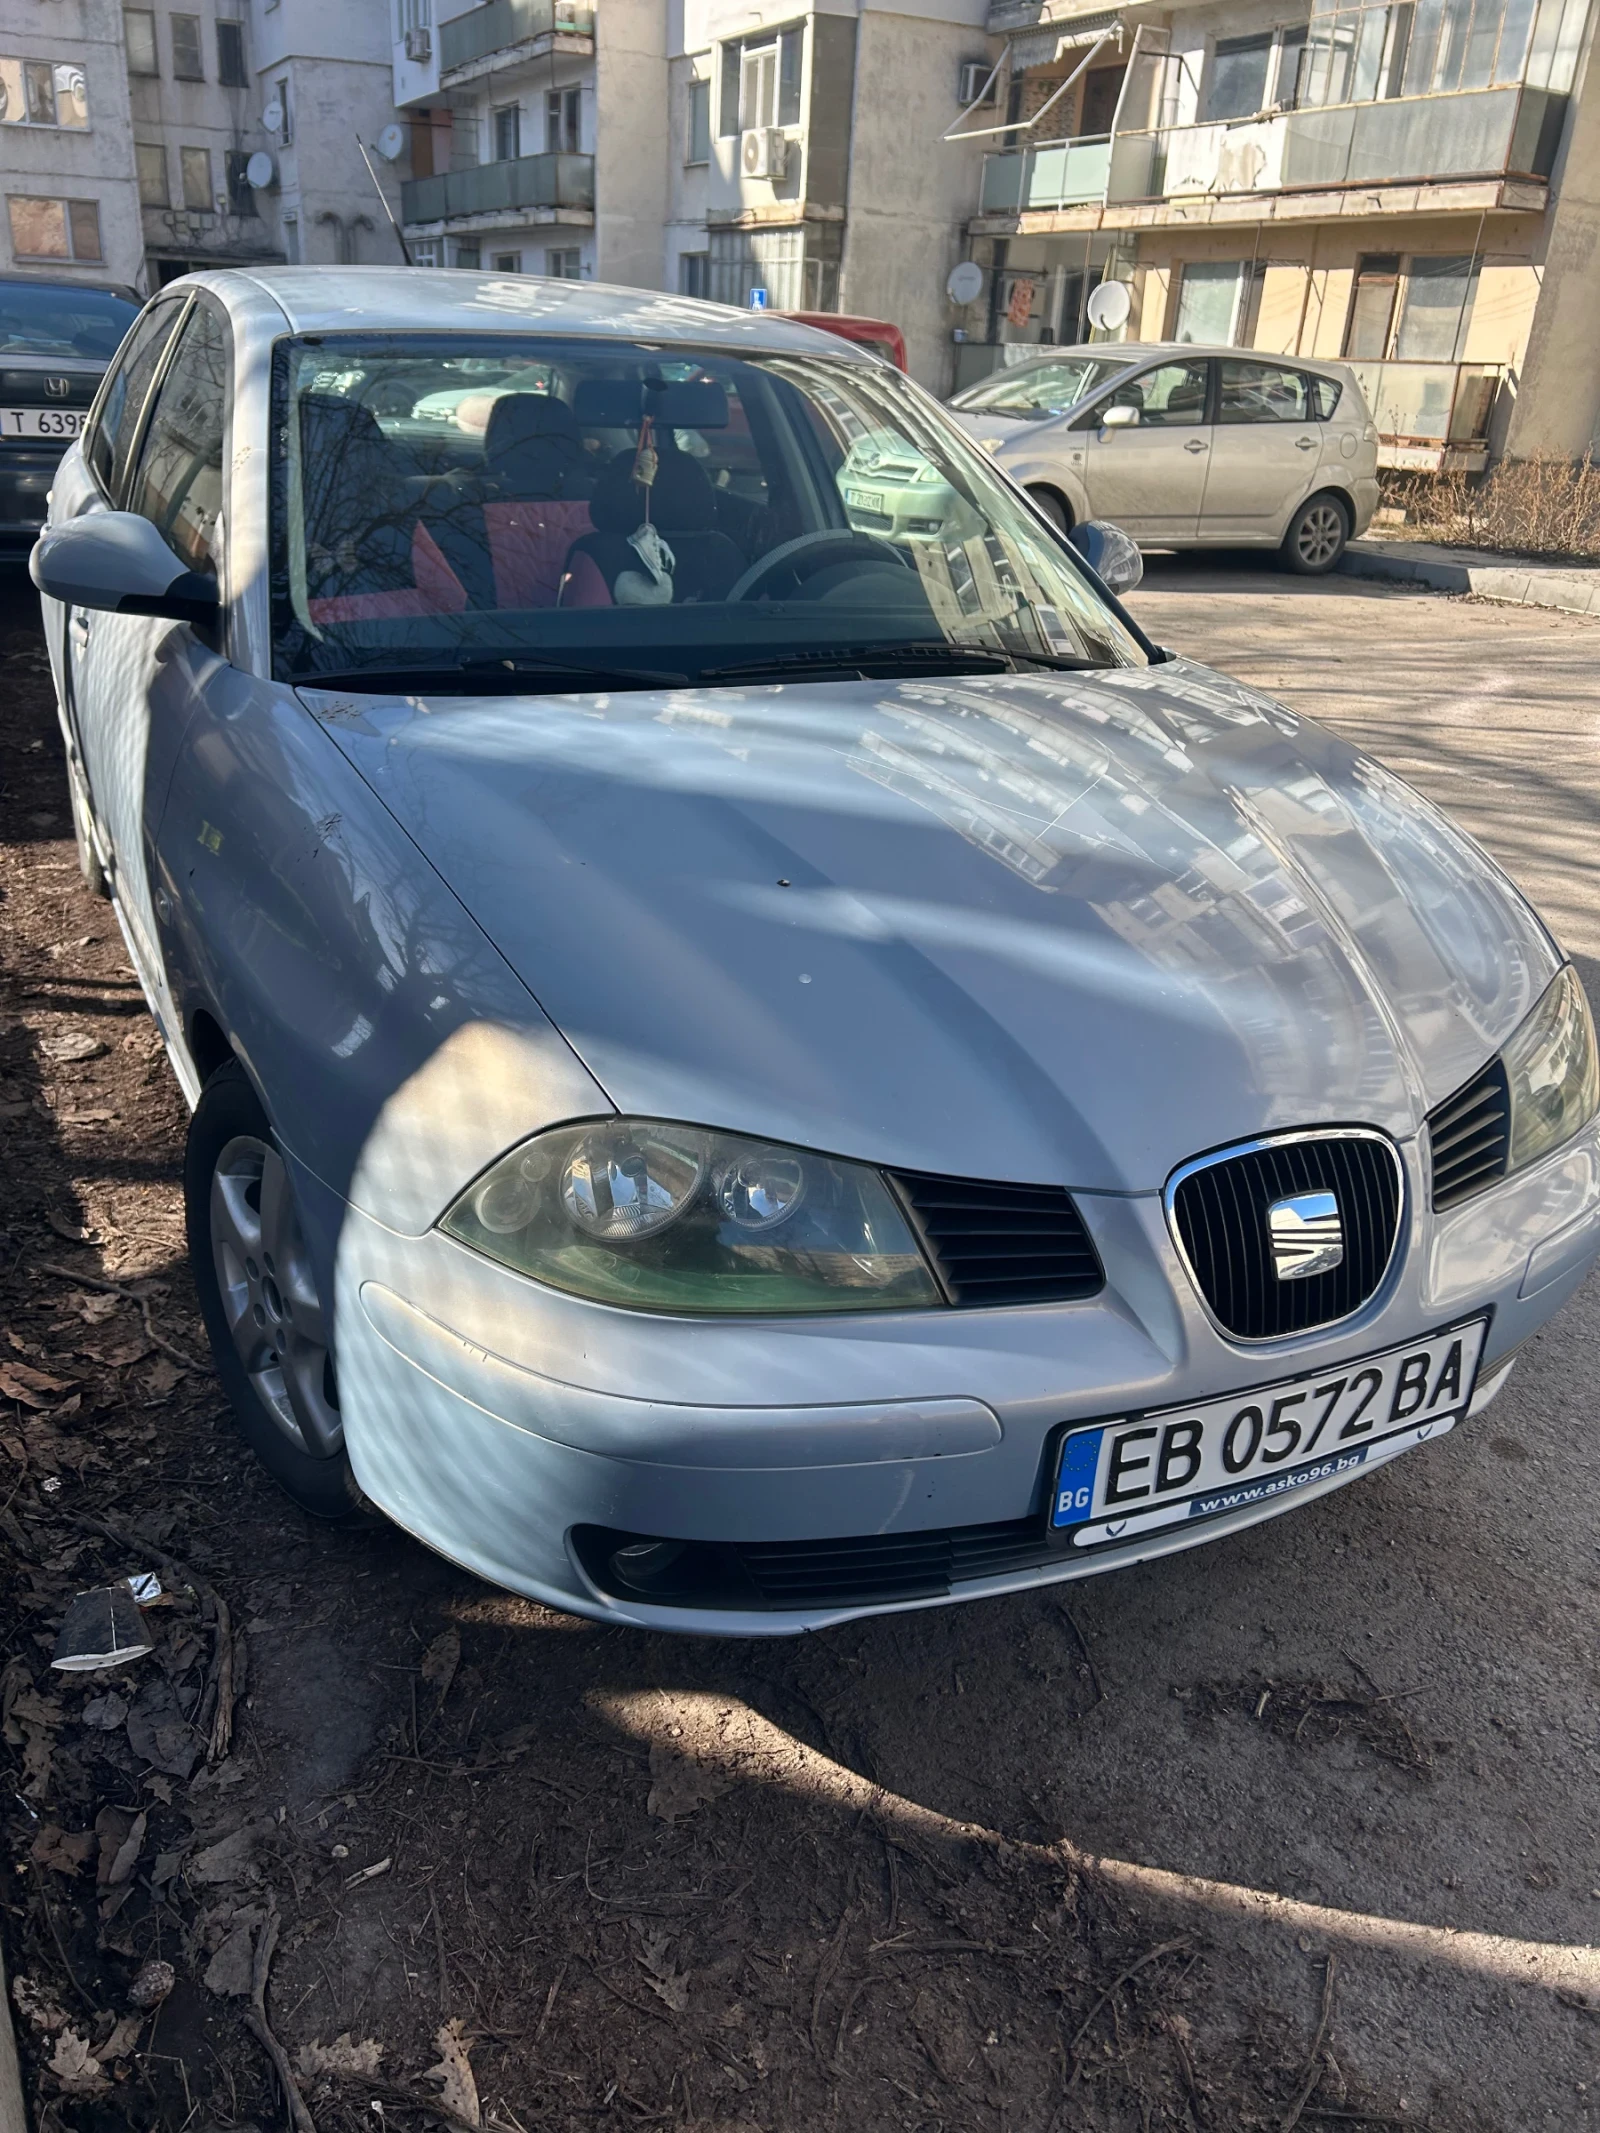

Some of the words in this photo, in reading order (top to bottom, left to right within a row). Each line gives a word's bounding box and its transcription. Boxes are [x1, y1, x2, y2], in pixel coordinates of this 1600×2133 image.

[10, 411, 24, 433] T
[1104, 1419, 1204, 1506] EB
[1222, 1367, 1384, 1474] 0572
[1387, 1338, 1463, 1423] BA
[1057, 1486, 1091, 1513] BG
[1200, 1453, 1360, 1513] www.asko96.bg
